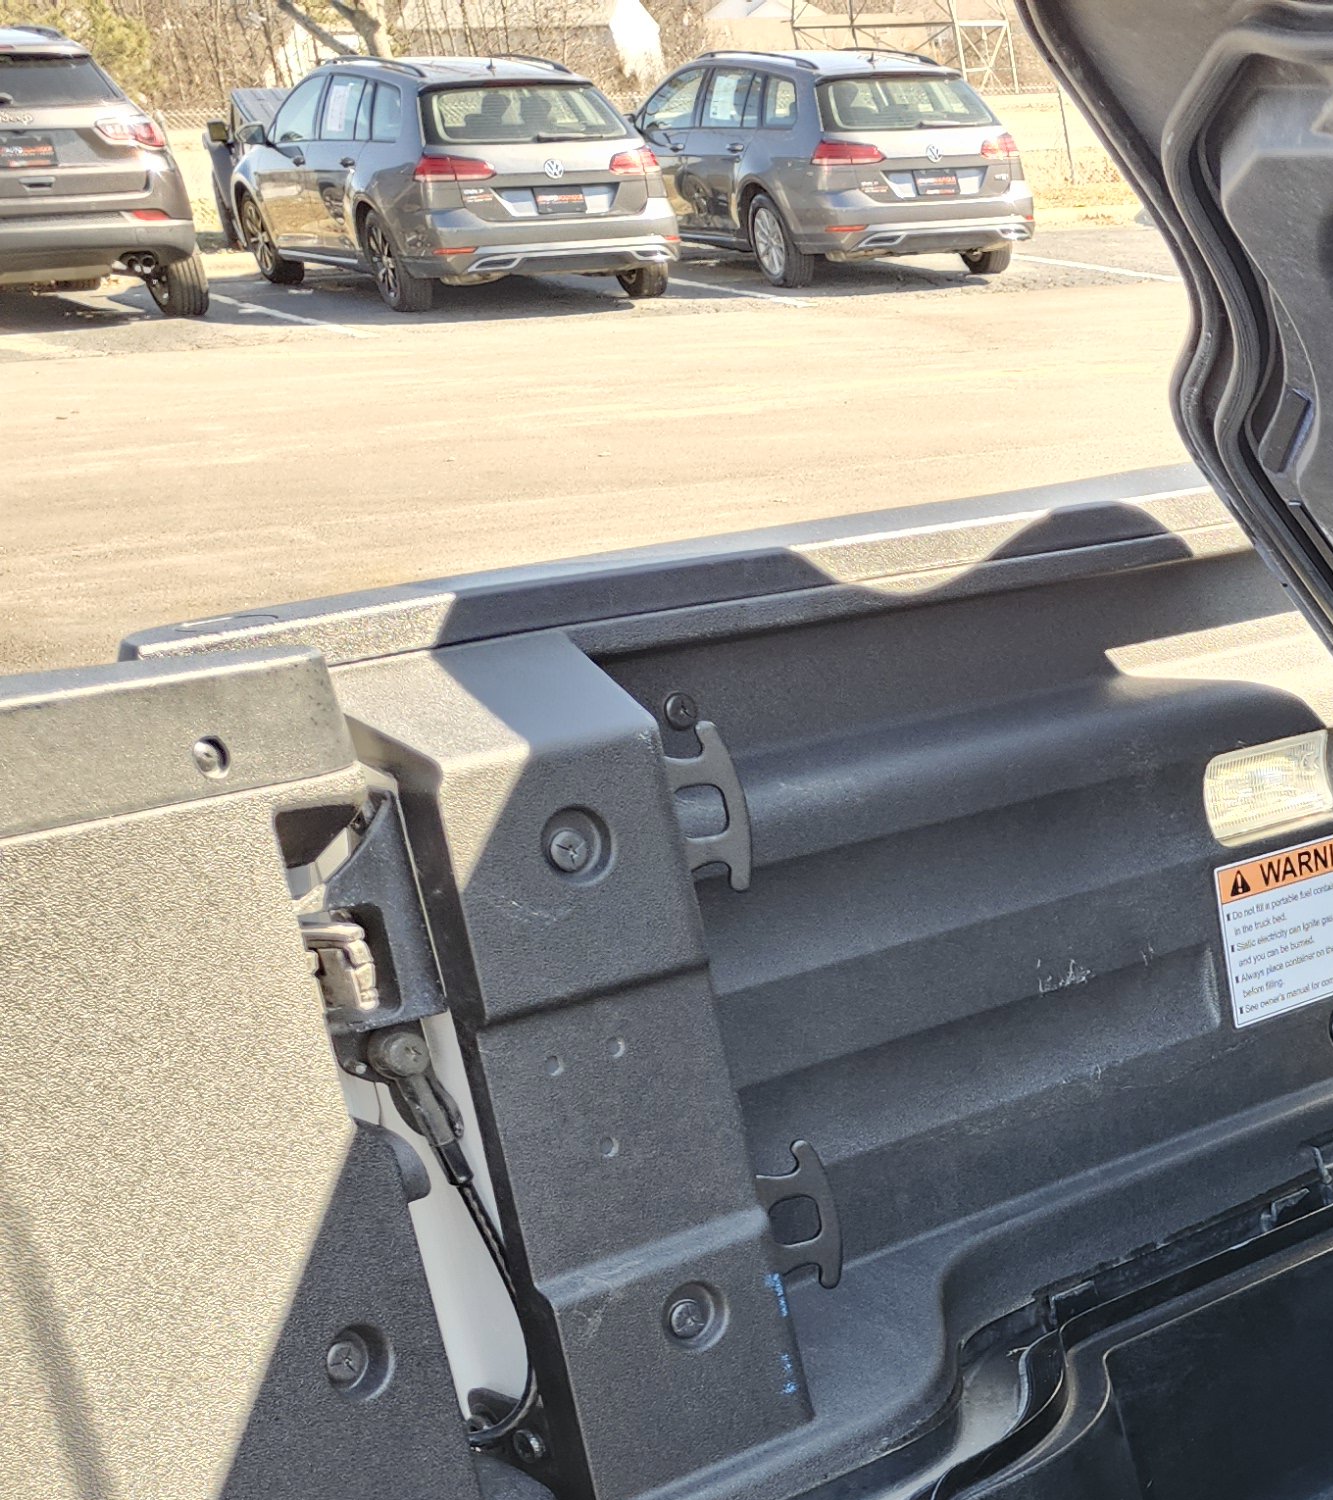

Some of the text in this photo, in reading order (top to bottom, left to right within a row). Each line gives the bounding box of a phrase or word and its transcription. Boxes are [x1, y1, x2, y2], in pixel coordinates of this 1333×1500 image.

[1232, 910, 1243, 920] Do
[1244, 905, 1255, 917] not
[1271, 893, 1299, 910] portable
[1300, 887, 1312, 899] fuel
[1234, 927, 1241, 936] in
[1243, 922, 1253, 933] the
[1254, 917, 1271, 930] truck
[1236, 938, 1256, 952] Static
[1257, 927, 1288, 945] electricity
[1289, 925, 1301, 935] can
[1322, 915, 1333, 927] gas
[1239, 955, 1252, 968] and
[1253, 952, 1266, 965] you
[1267, 948, 1279, 959] can
[1280, 943, 1289, 954] be
[1241, 966, 1265, 983] Always
[1266, 960, 1283, 976] place
[1285, 951, 1315, 968] container
[1316, 948, 1325, 959] on
[1242, 985, 1265, 998] before
[1245, 1002, 1259, 1014] See
[1260, 993, 1285, 1009] owner's
[1286, 983, 1311, 999] manual
[1311, 979, 1320, 991] for
